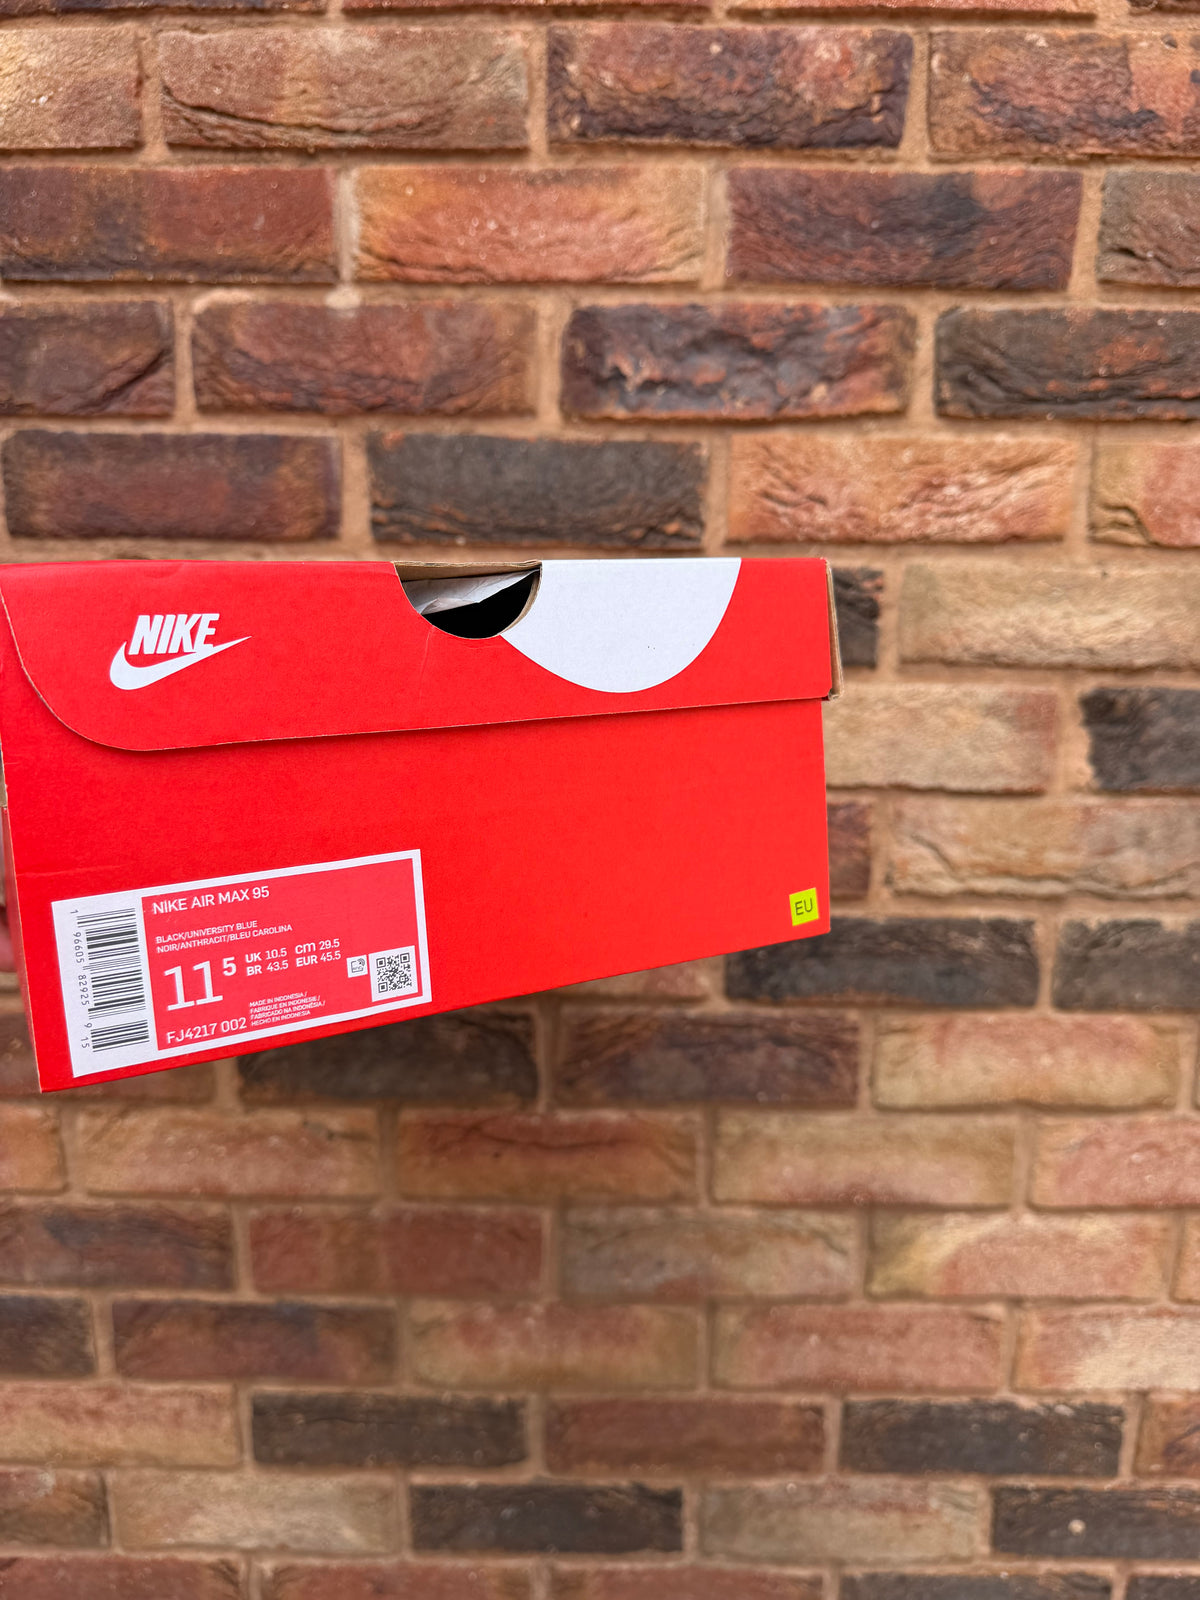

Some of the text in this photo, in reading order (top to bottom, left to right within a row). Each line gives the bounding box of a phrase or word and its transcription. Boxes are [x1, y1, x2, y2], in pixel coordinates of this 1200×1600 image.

[128, 613, 220, 655] NIKE
[152, 886, 270, 914] NIKE AIR MAX 95
[795, 898, 813, 915] EU
[155, 920, 258, 944] BLACK/UNIVERSITY BLUE
[156, 924, 293, 953] NOIR/ANTHRACIT/BLEU CAROLINA
[73, 932, 85, 963] 96605
[245, 938, 341, 963] UK 10.5 cm 29.5
[246, 950, 342, 976] BR 43.5 EUR 45.5
[78, 974, 90, 1006] 82925
[164, 956, 237, 1011] 11 5
[166, 1017, 247, 1043] FJ4217 002
